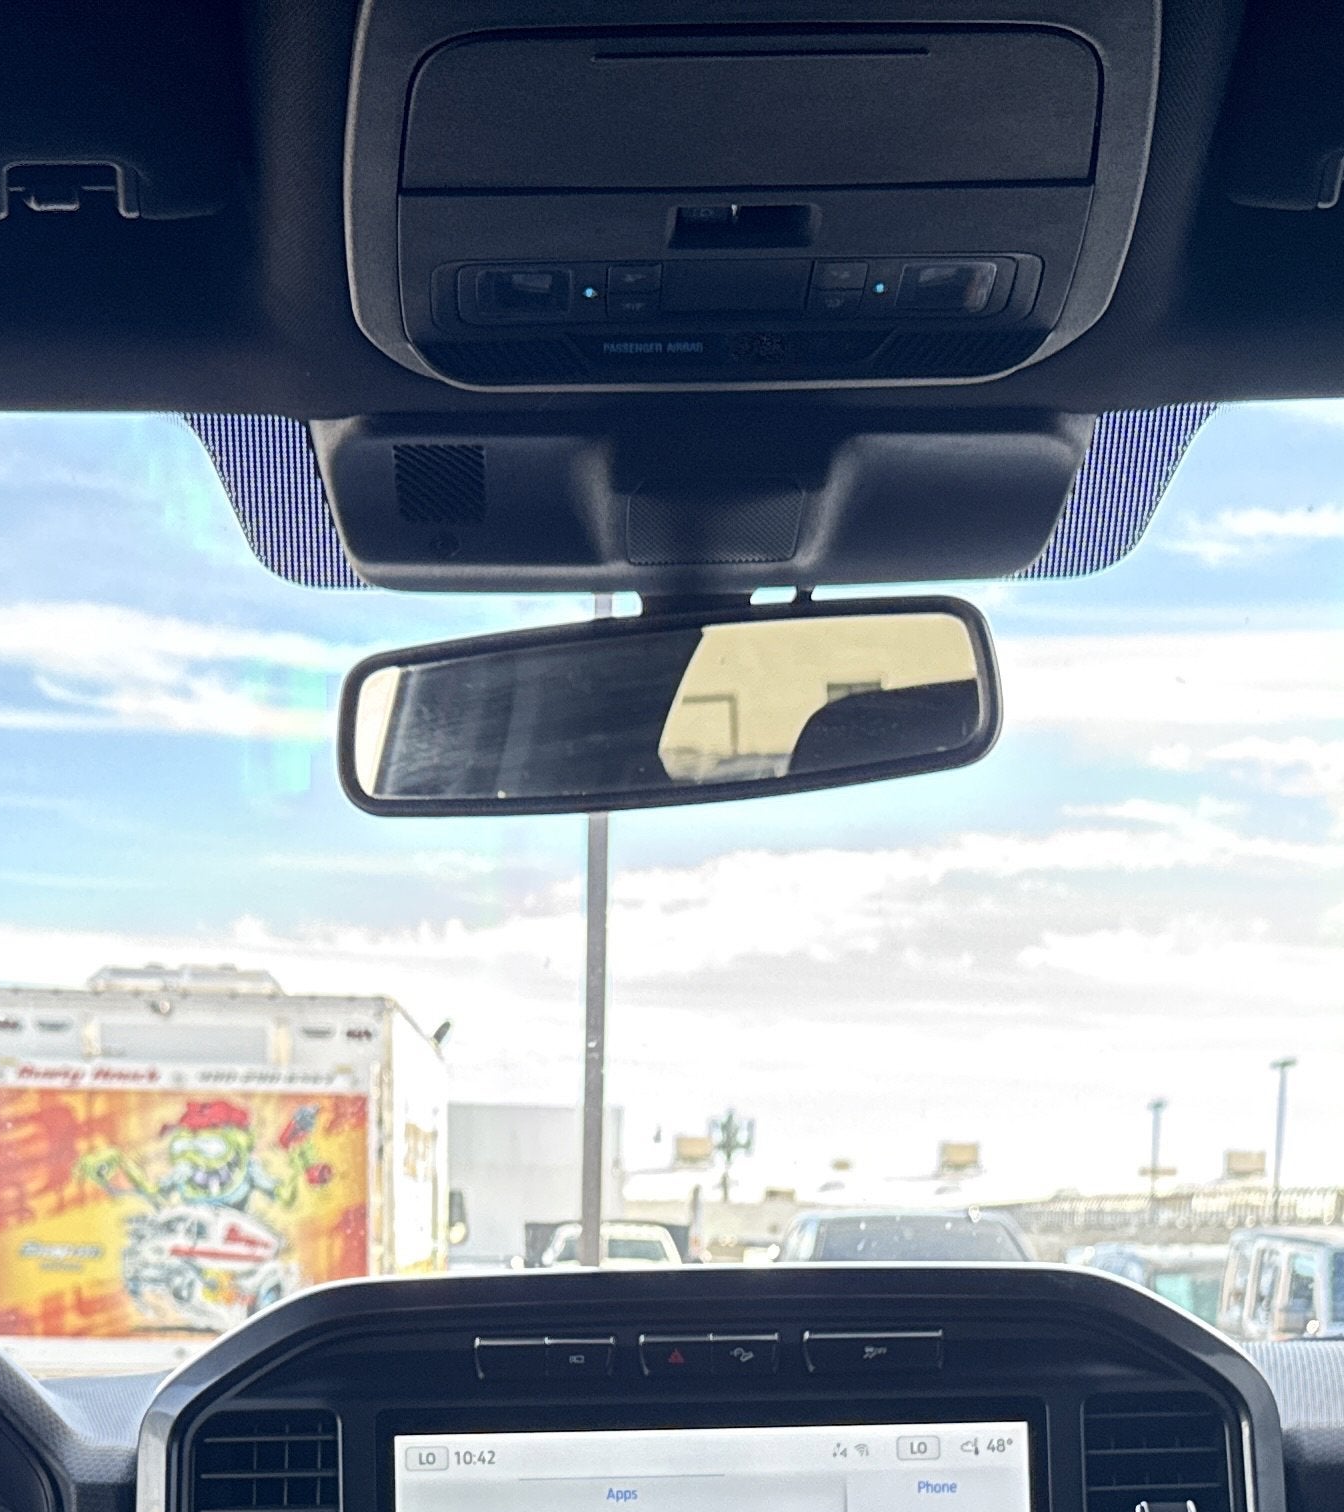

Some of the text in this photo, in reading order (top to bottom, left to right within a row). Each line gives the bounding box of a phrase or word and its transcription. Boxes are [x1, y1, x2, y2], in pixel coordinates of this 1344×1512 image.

[910, 1438, 1013, 1455] LO 48°
[418, 1449, 496, 1466] LO 10:42
[606, 1487, 638, 1502] Apps
[917, 1480, 957, 1494] Phone
